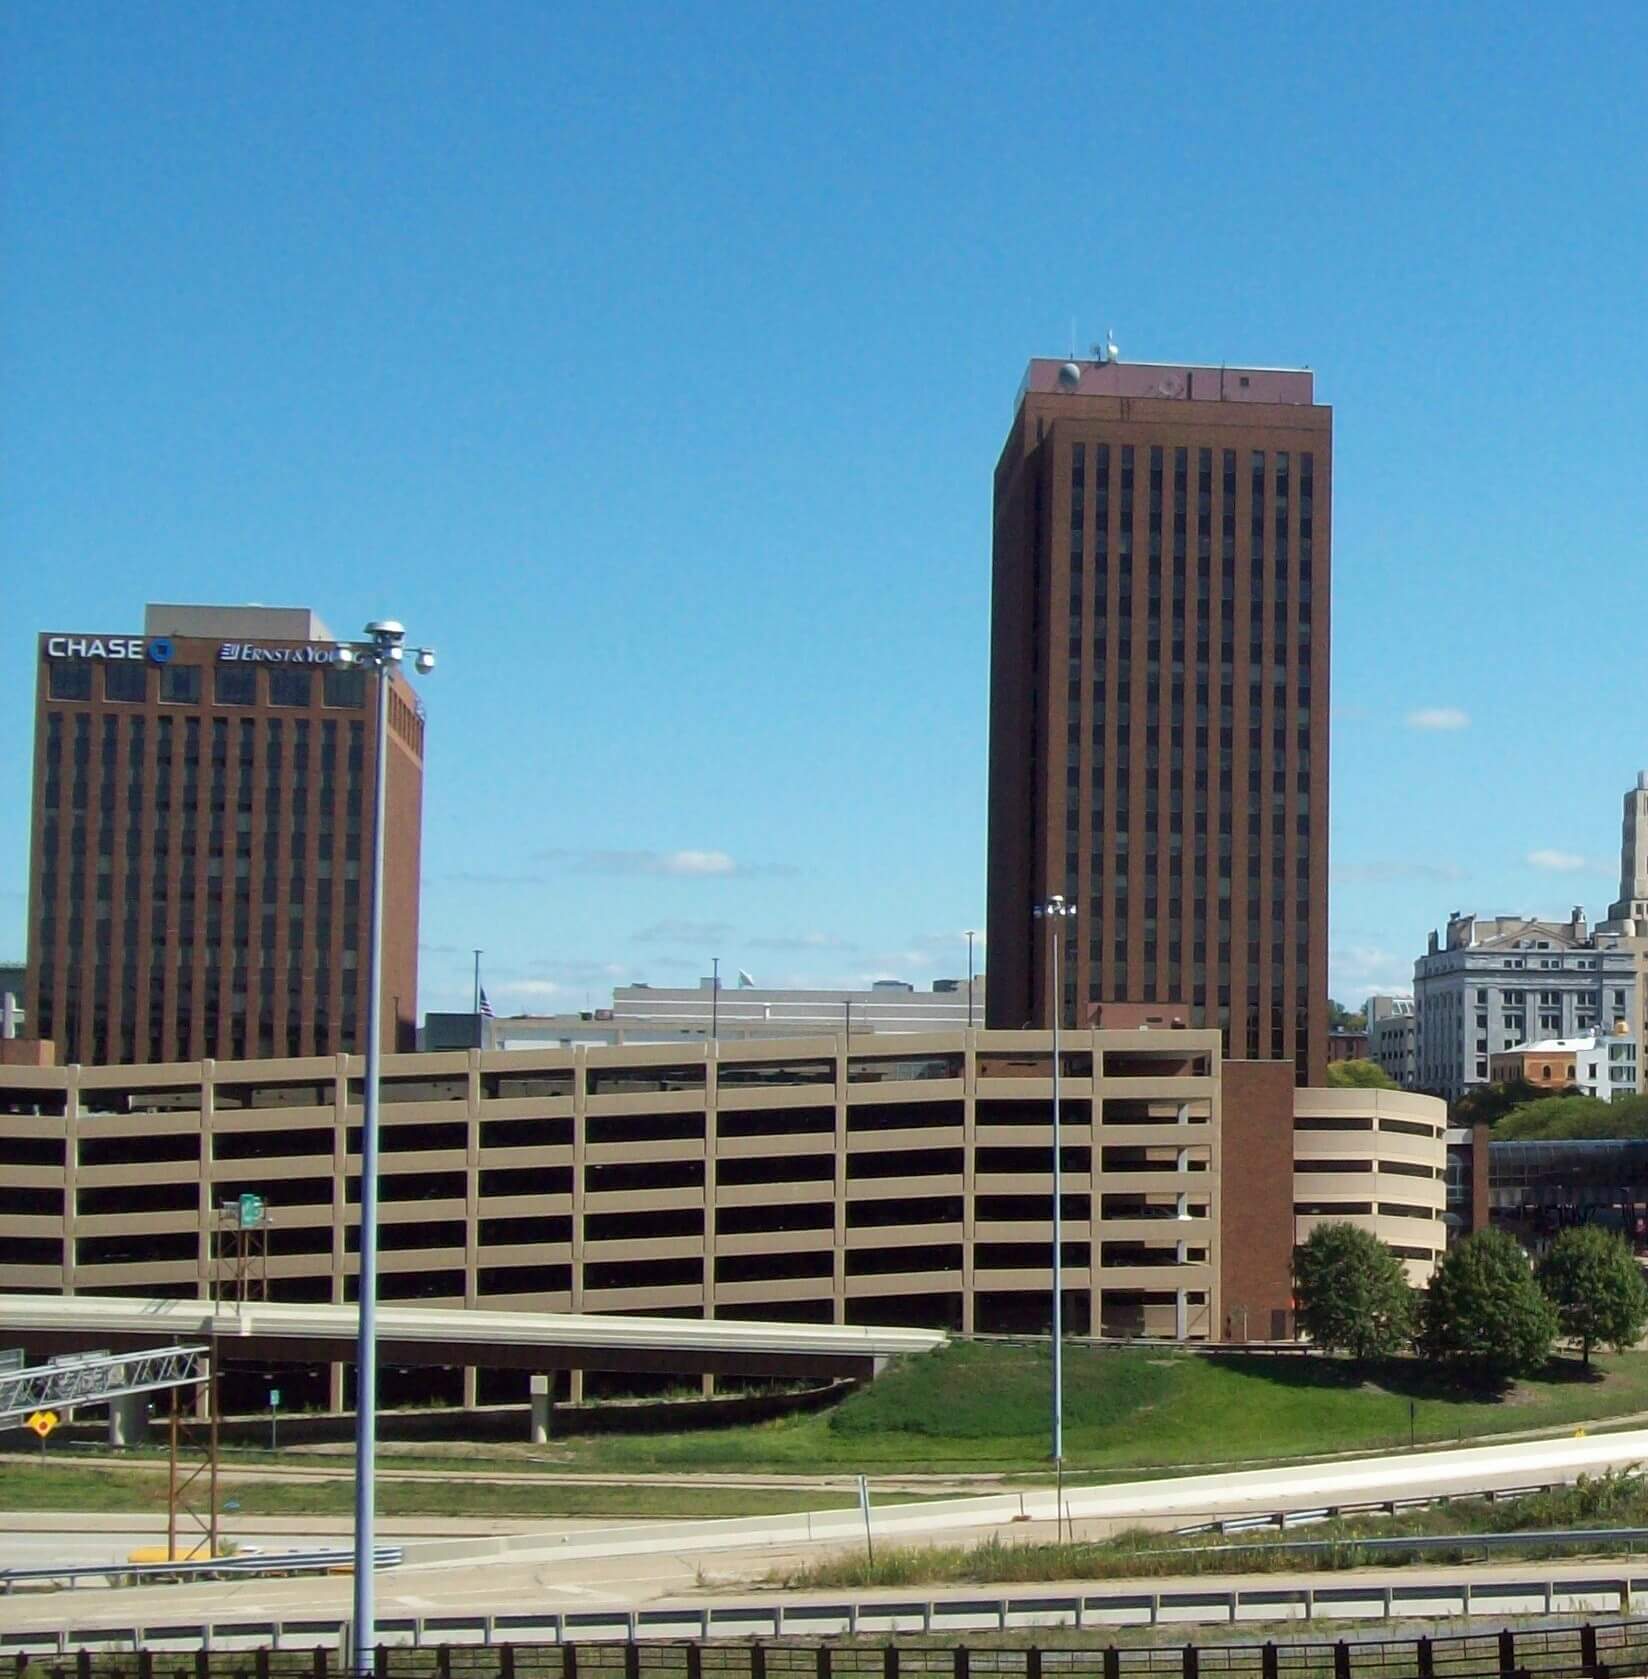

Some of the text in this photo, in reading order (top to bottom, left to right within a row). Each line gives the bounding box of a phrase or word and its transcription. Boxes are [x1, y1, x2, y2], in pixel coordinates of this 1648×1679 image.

[48, 637, 144, 660] CHASE
[241, 644, 290, 662] ERNST
[304, 646, 365, 665] YOG
